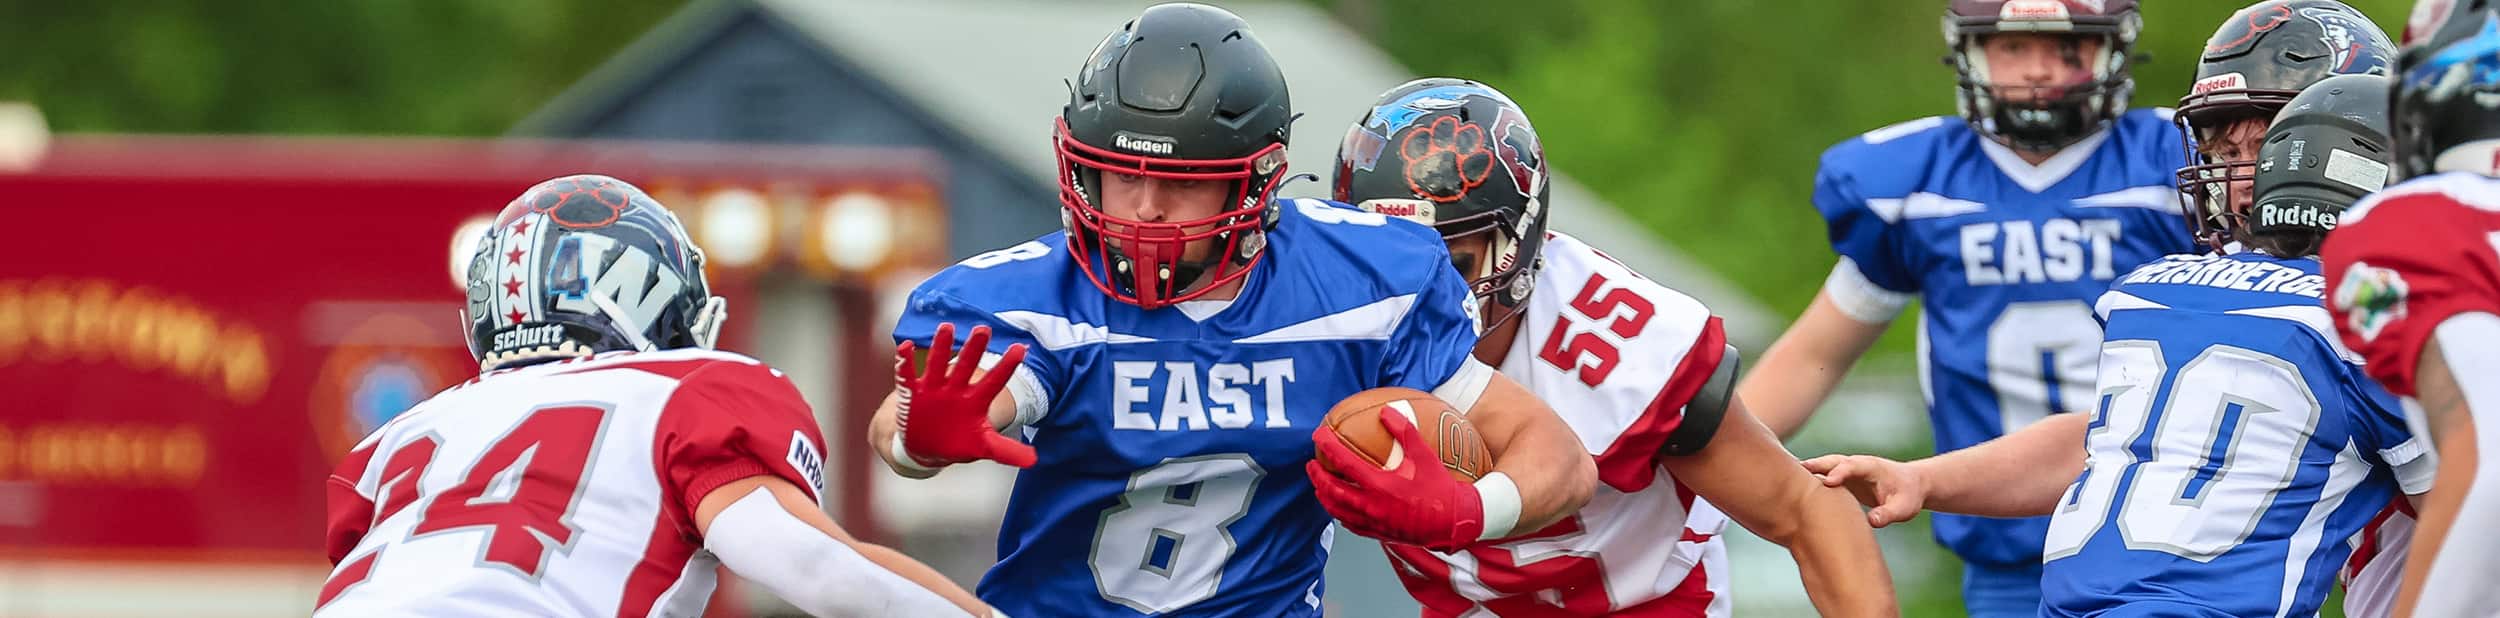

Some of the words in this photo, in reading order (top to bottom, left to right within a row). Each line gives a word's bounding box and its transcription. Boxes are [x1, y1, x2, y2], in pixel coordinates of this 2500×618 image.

[2196, 76, 2236, 94] Riddell
[1116, 135, 1173, 154] Riddell
[1375, 203, 1416, 217] Riddell
[547, 235, 590, 300] 4
[1960, 218, 2121, 286] EAST
[2121, 256, 2327, 300] HERSHBERGE
[494, 323, 564, 352] schutt
[1536, 271, 1656, 389] 55
[1113, 357, 1296, 432] EAST
[1087, 452, 1268, 615] 8
